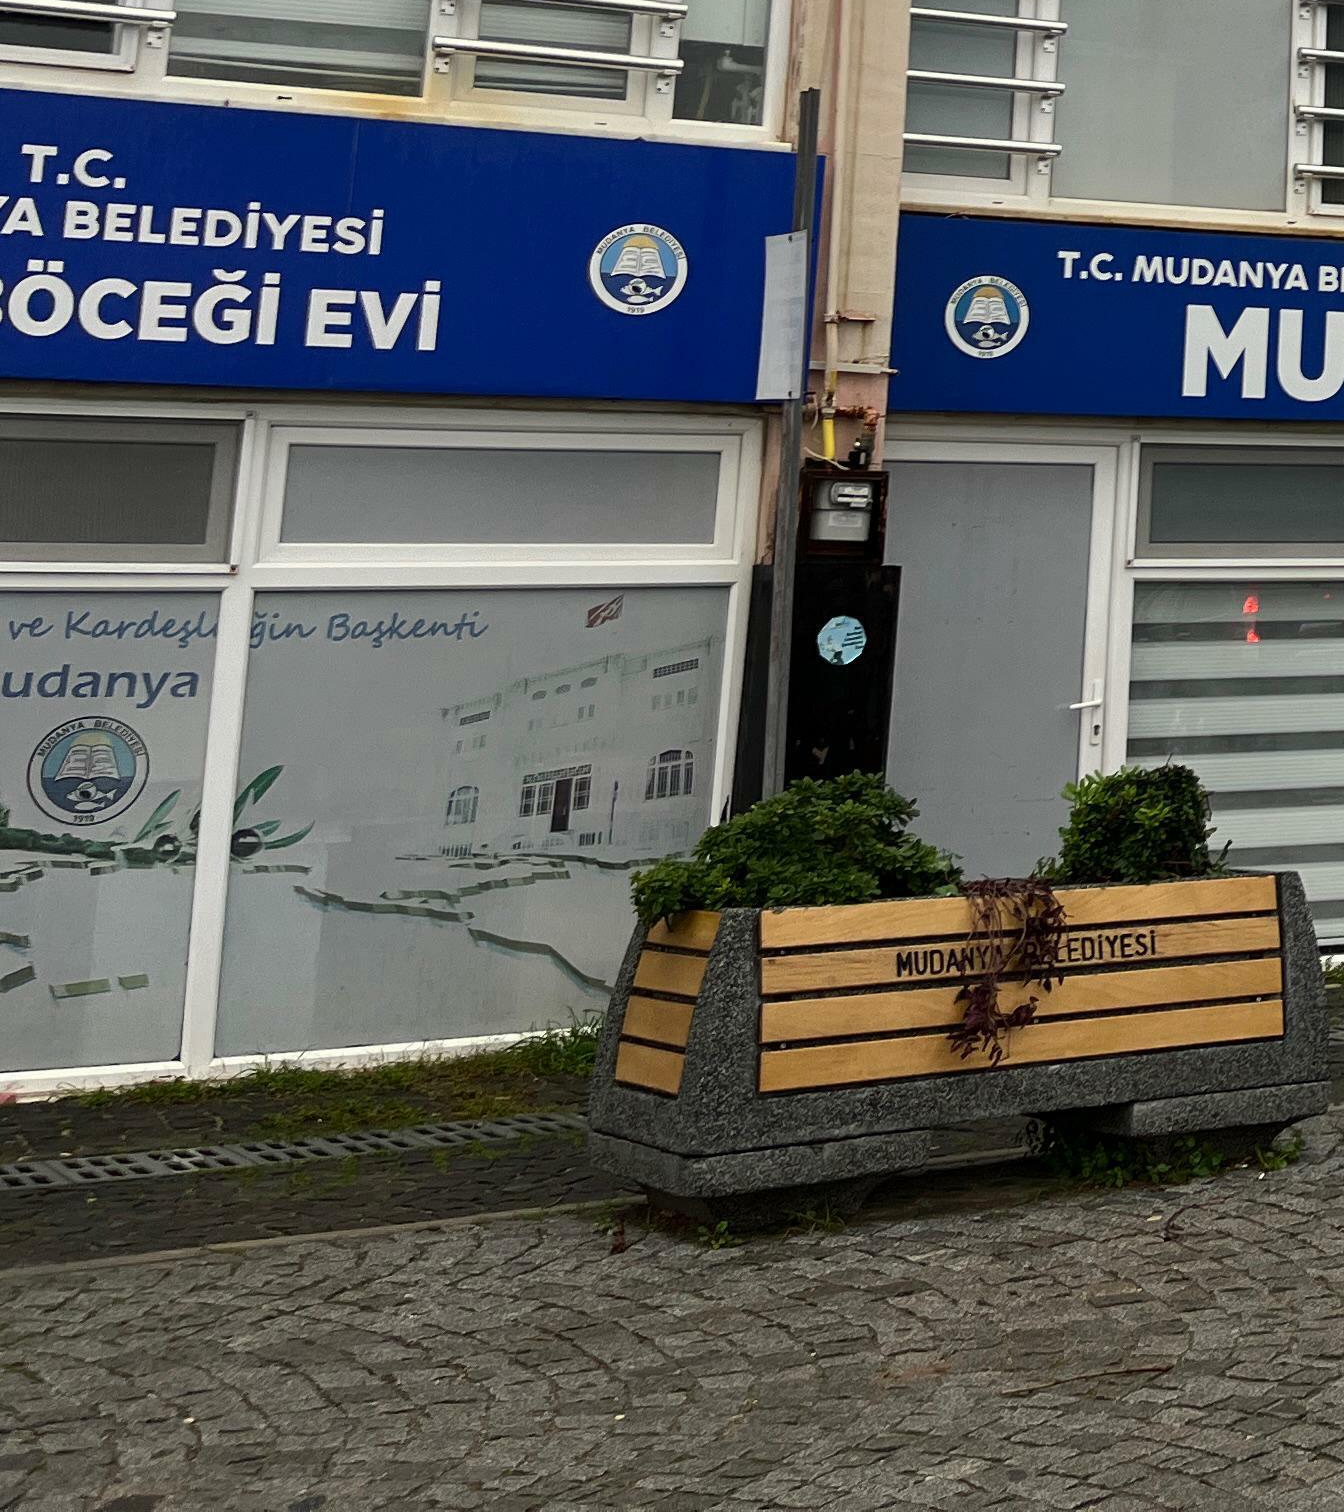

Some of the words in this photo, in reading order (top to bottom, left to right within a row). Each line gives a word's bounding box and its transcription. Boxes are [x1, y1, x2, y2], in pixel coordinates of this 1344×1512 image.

[21, 144, 127, 188] T.C.
[63, 201, 384, 255] BELEDİYESİ
[1057, 250, 1123, 281] T.C.
[1132, 255, 1309, 291] MUDANYA
[0, 259, 281, 345] ÖCEĞİ
[304, 280, 441, 351] EVİ
[9, 616, 54, 639] ve
[326, 613, 489, 648] Başkenti
[37, 720, 85, 757] MUDANYA
